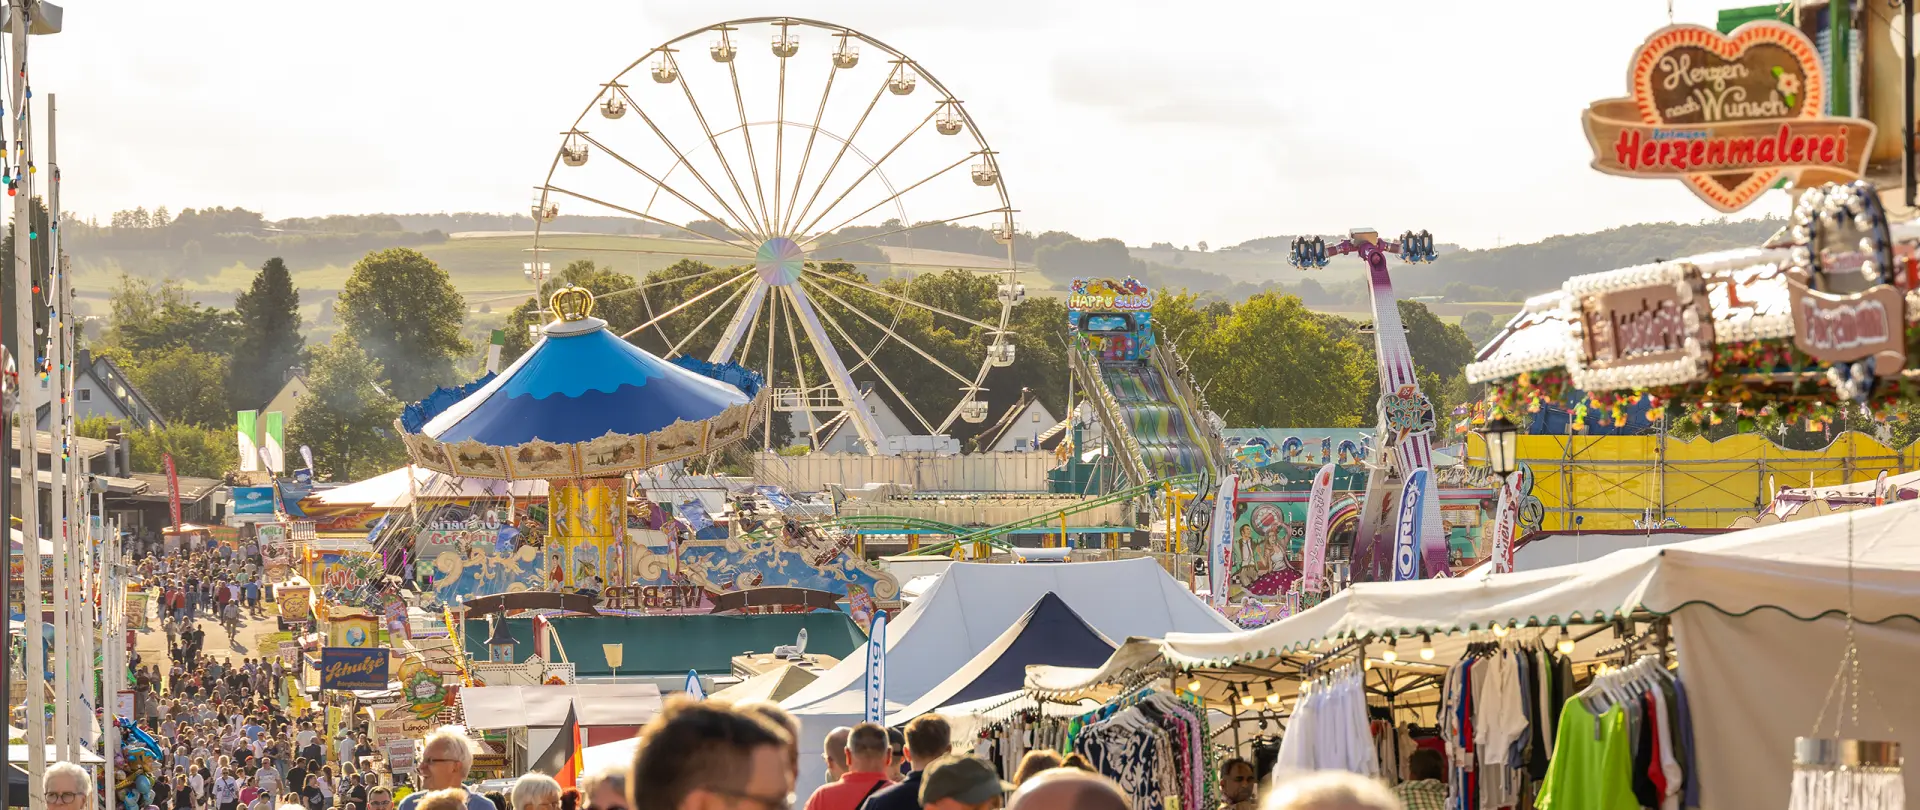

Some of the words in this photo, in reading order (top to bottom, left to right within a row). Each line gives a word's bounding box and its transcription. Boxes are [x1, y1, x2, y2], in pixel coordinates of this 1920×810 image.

[1660, 54, 1748, 91] Herzen
[1665, 100, 1701, 119] nach
[1697, 86, 1788, 120] Wunsch
[1615, 122, 1849, 170] Herzenmalerei
[1114, 295, 1150, 309] SLIDE
[1384, 393, 1430, 412] Rock
[1390, 410, 1433, 431] Roll
[1222, 496, 1233, 545] Riegel
[1399, 490, 1417, 577] OREO
